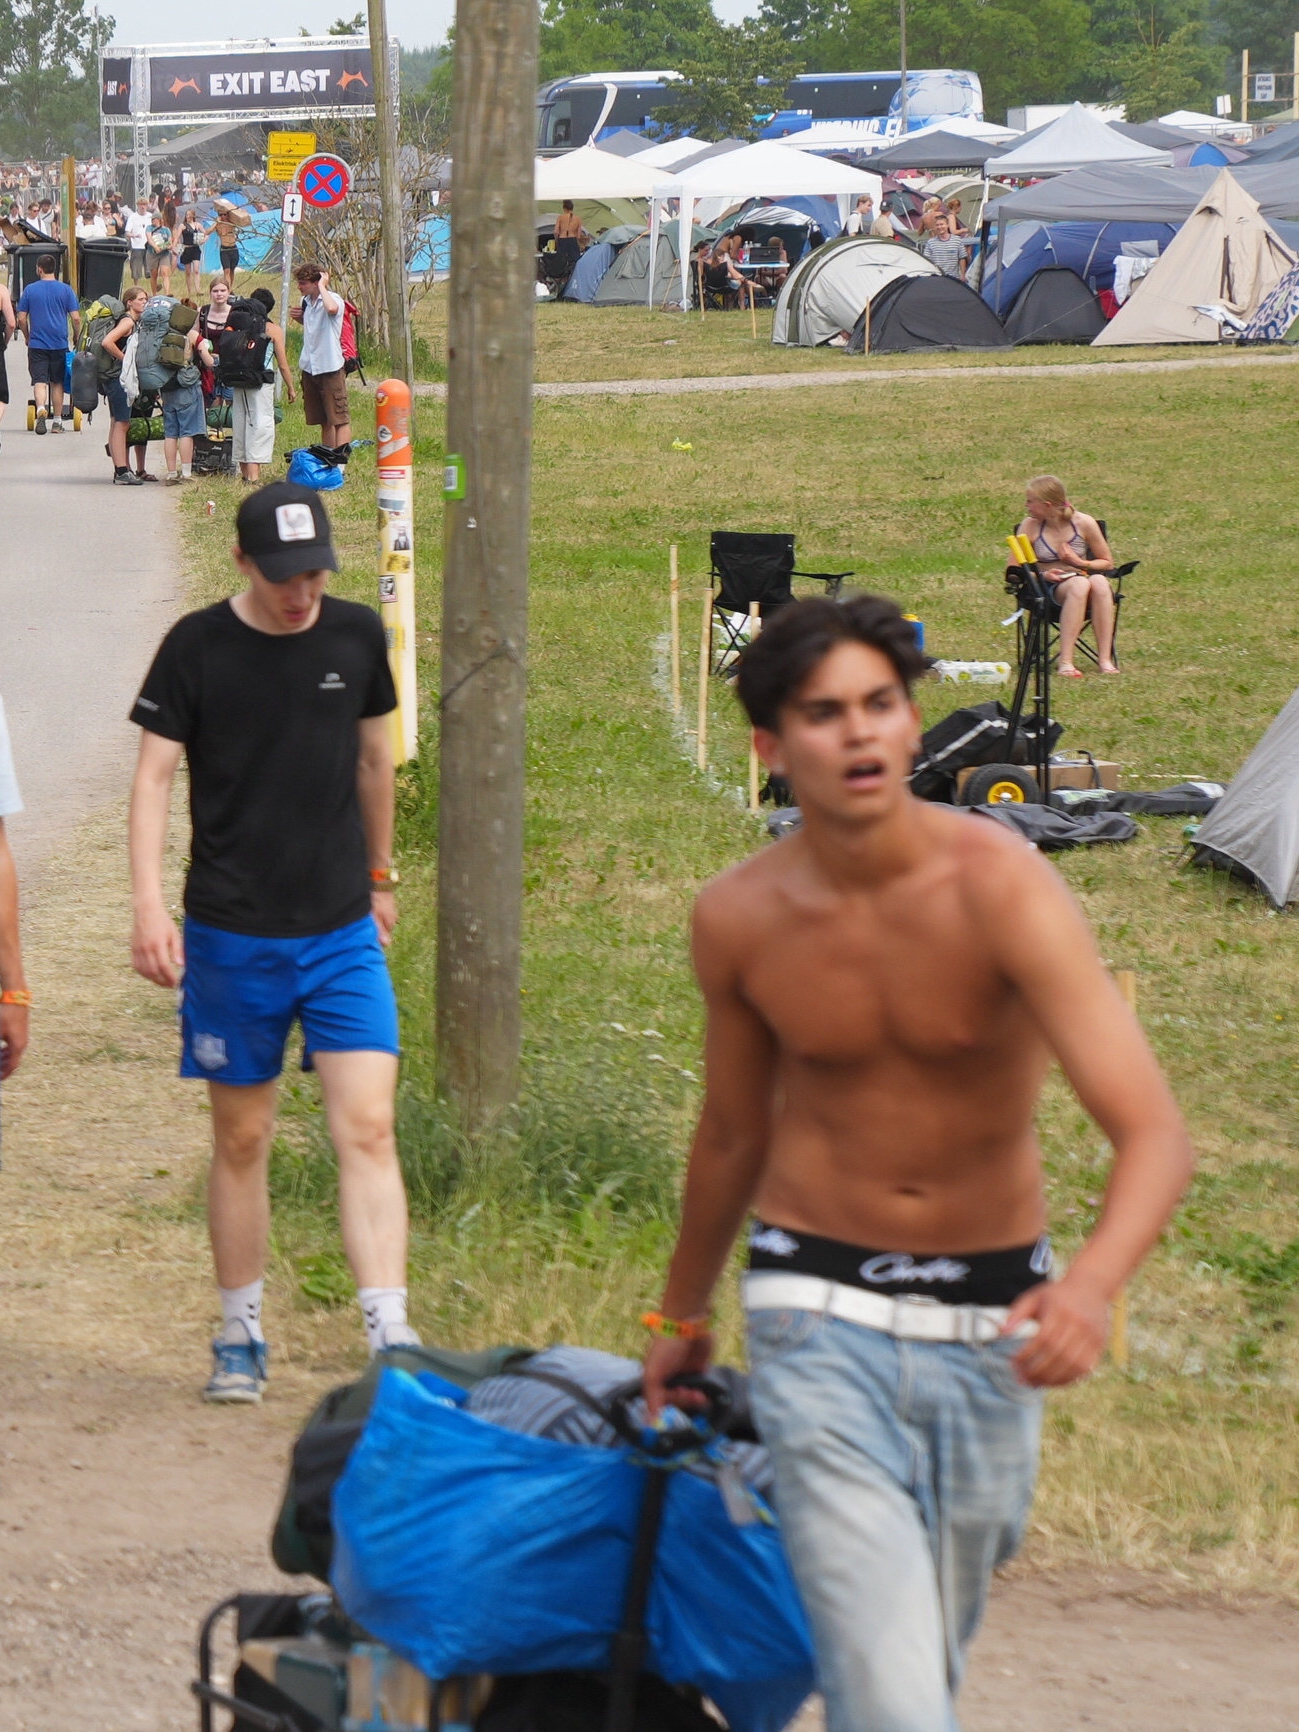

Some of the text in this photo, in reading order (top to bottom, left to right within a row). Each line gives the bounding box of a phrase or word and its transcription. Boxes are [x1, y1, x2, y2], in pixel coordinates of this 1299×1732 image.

[107, 80, 118, 96] EAST
[210, 69, 331, 96] EXIT EAST
